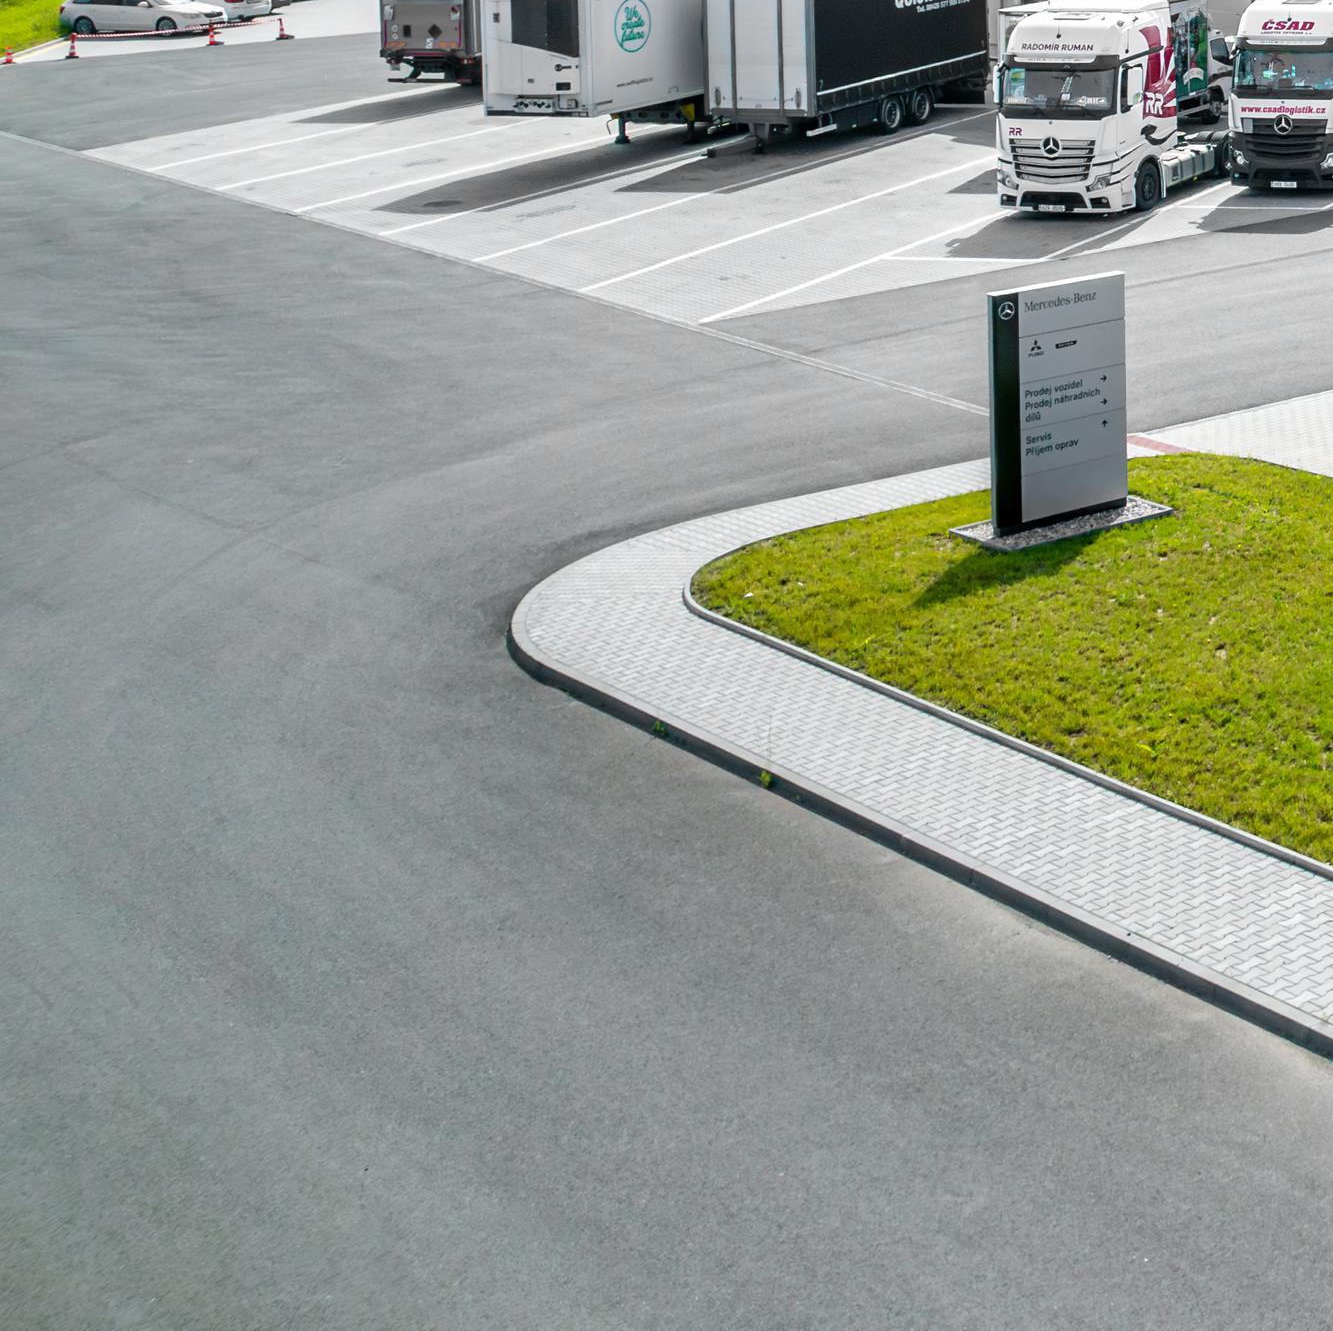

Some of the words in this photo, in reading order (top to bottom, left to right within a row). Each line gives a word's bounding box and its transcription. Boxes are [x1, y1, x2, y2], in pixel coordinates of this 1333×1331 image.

[1261, 18, 1315, 31] ČSAD
[1021, 42, 1059, 51] RADOMÍR
[1145, 92, 1164, 115] RR
[1240, 105, 1326, 115] www.csadlogistik.cz
[1009, 127, 1023, 136] RR
[1024, 292, 1097, 312] Mercedes-Benz
[1025, 386, 1052, 398] Prodej
[1054, 379, 1083, 392] vozidel
[1025, 398, 1052, 410] Prodej
[1026, 432, 1052, 445] Servis
[1055, 439, 1079, 451] oprav
